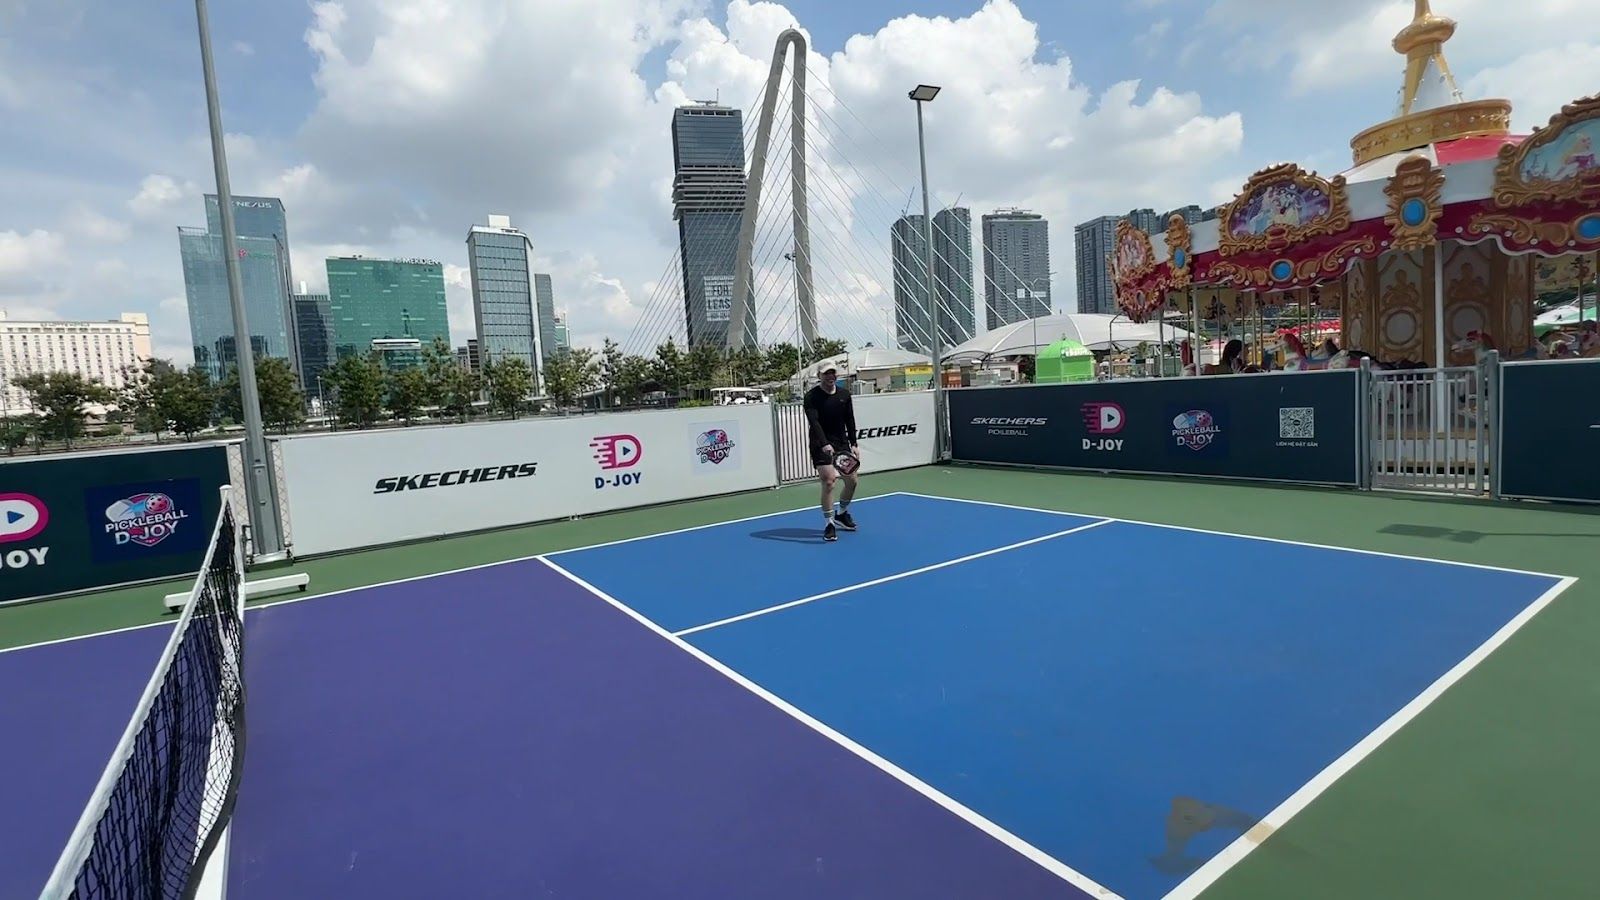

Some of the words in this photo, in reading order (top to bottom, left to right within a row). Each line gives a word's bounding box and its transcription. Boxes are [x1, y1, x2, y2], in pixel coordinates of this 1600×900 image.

[707, 298, 731, 310] LEAS
[970, 417, 1048, 425] SKECHERS
[855, 423, 918, 440] ECHERS
[1171, 425, 1222, 436] PICKLEBALL
[1082, 438, 1124, 451] D-JOY
[1176, 433, 1214, 446] D-JOY
[373, 462, 538, 495] SKECHERS
[594, 471, 642, 490] D-JOY
[105, 509, 189, 533] PICKLEBALL
[114, 520, 179, 545] D-JOY
[0, 546, 49, 569] OY
